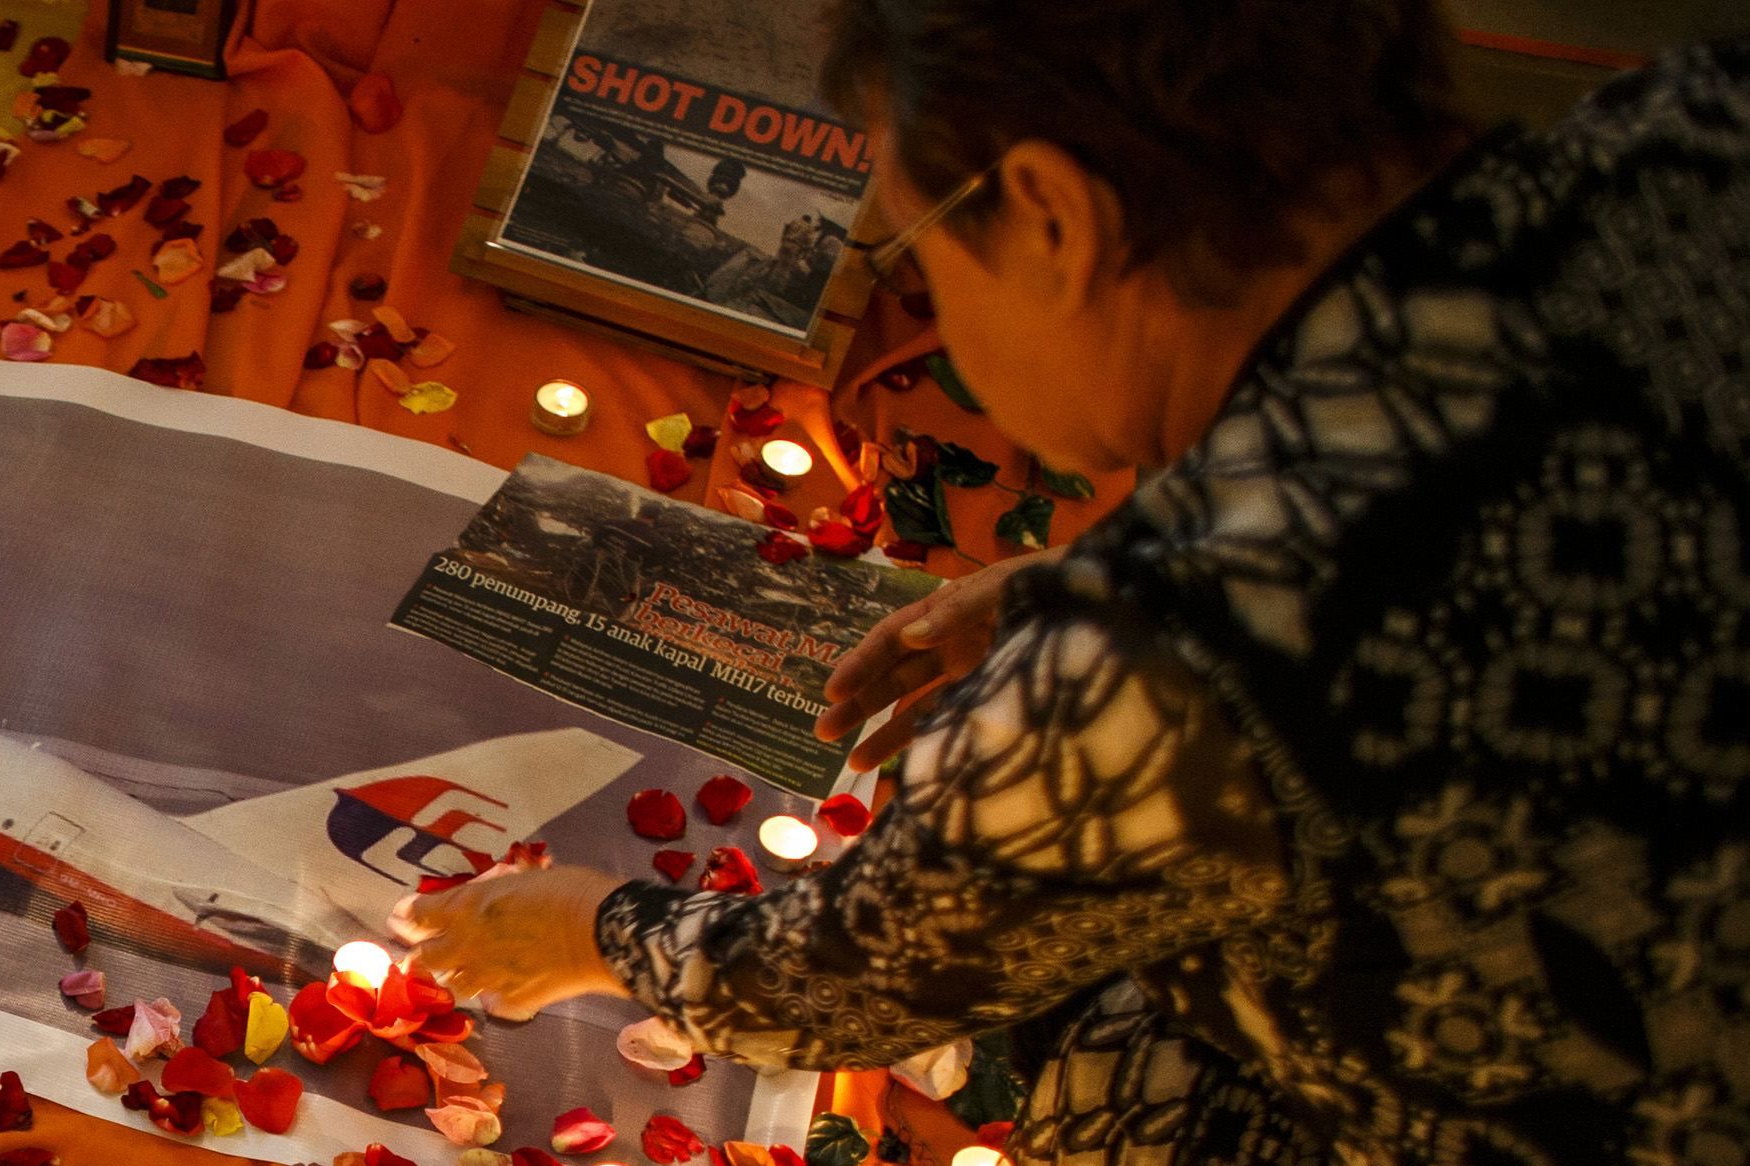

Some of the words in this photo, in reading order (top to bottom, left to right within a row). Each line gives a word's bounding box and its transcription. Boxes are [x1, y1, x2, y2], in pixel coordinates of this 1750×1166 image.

[567, 55, 705, 121] SHOT
[709, 94, 875, 173] DOWN!
[434, 556, 472, 580] 280
[470, 572, 582, 625] penumpang,
[585, 612, 609, 632] 15
[606, 624, 653, 651] anak
[653, 638, 707, 672] kapal
[710, 662, 768, 694] MH17
[634, 602, 786, 672] berkecai
[647, 581, 794, 651] Pesawat
